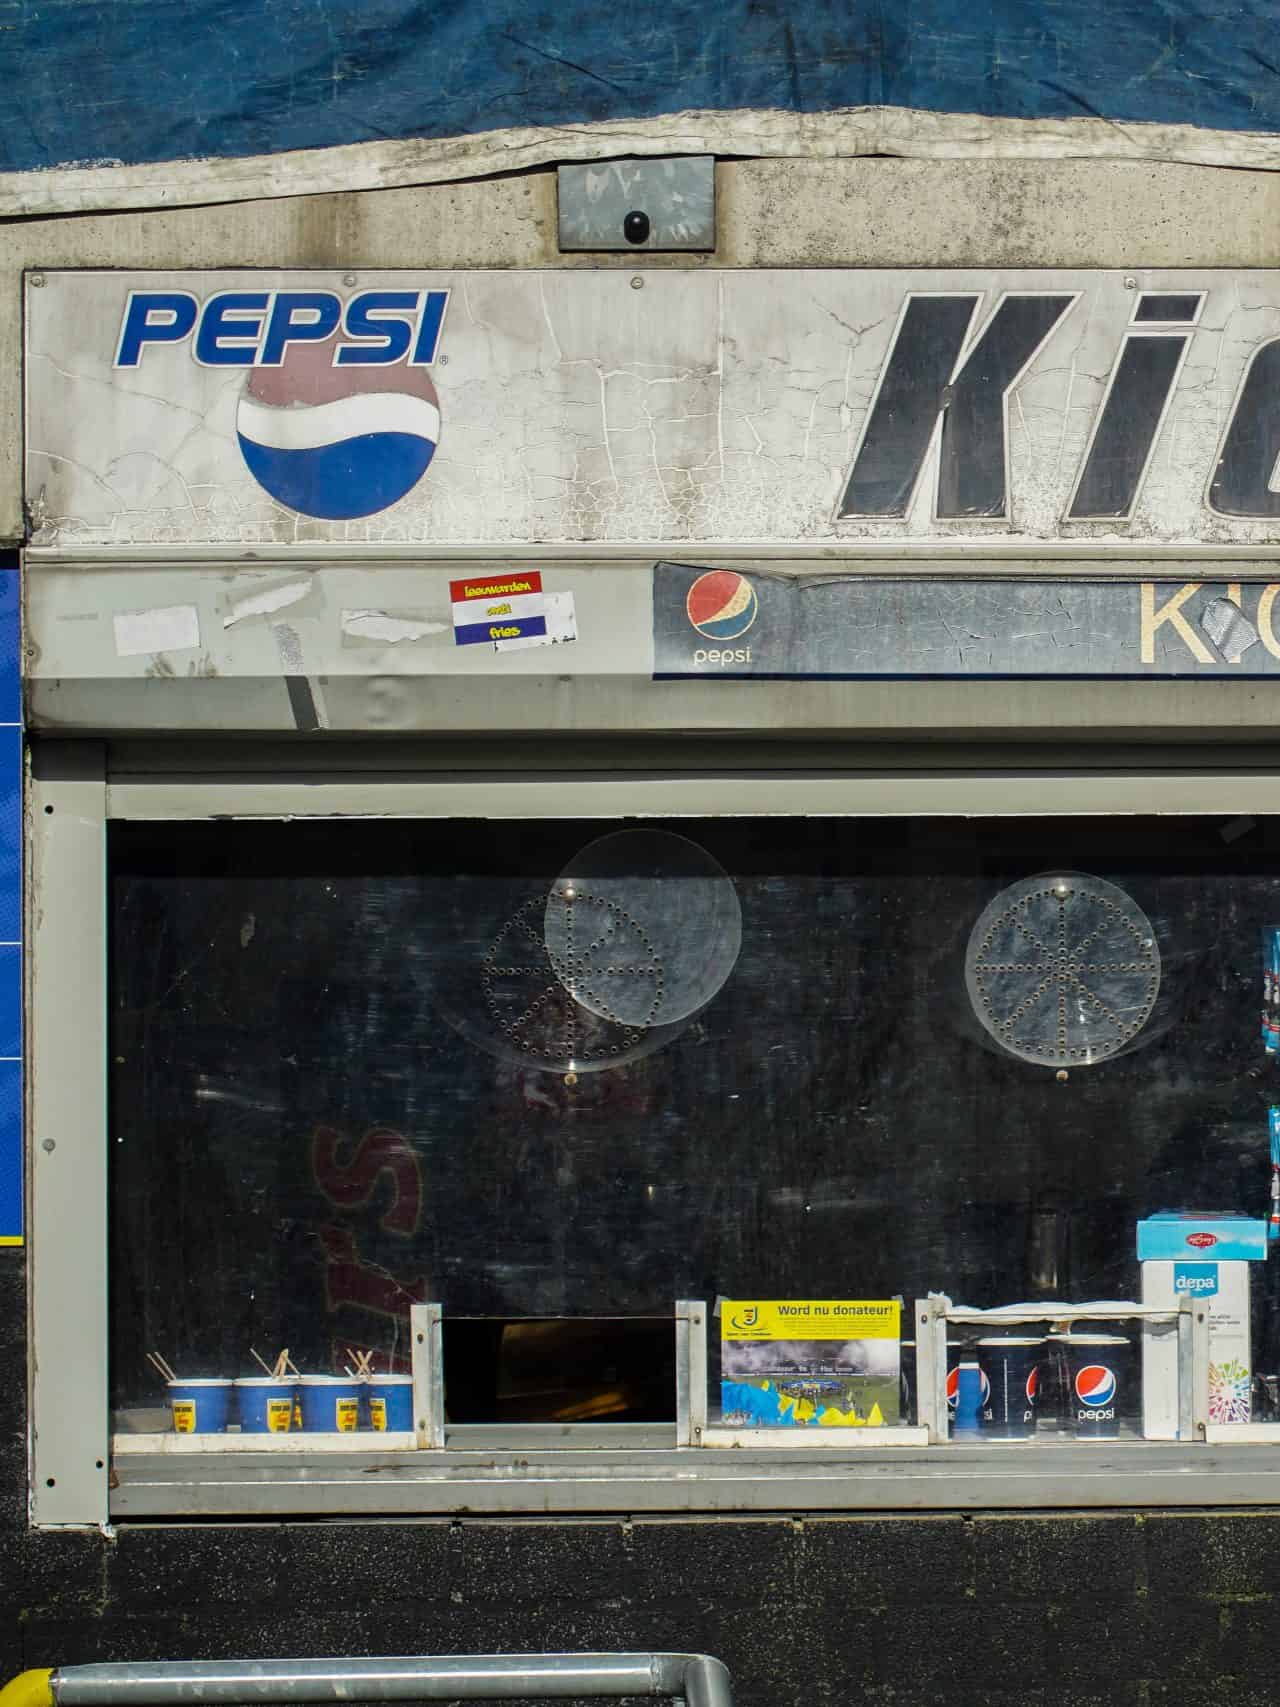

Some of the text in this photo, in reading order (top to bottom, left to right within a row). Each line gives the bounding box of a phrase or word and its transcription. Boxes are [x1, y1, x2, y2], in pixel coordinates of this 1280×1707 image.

[112, 289, 451, 368] PEPSI
[489, 627, 521, 639] fries
[693, 646, 751, 667] pepsi
[1176, 1275, 1215, 1292] depa
[778, 1305, 893, 1316] Word nu donateur!
[1078, 1408, 1115, 1422] pepsi
